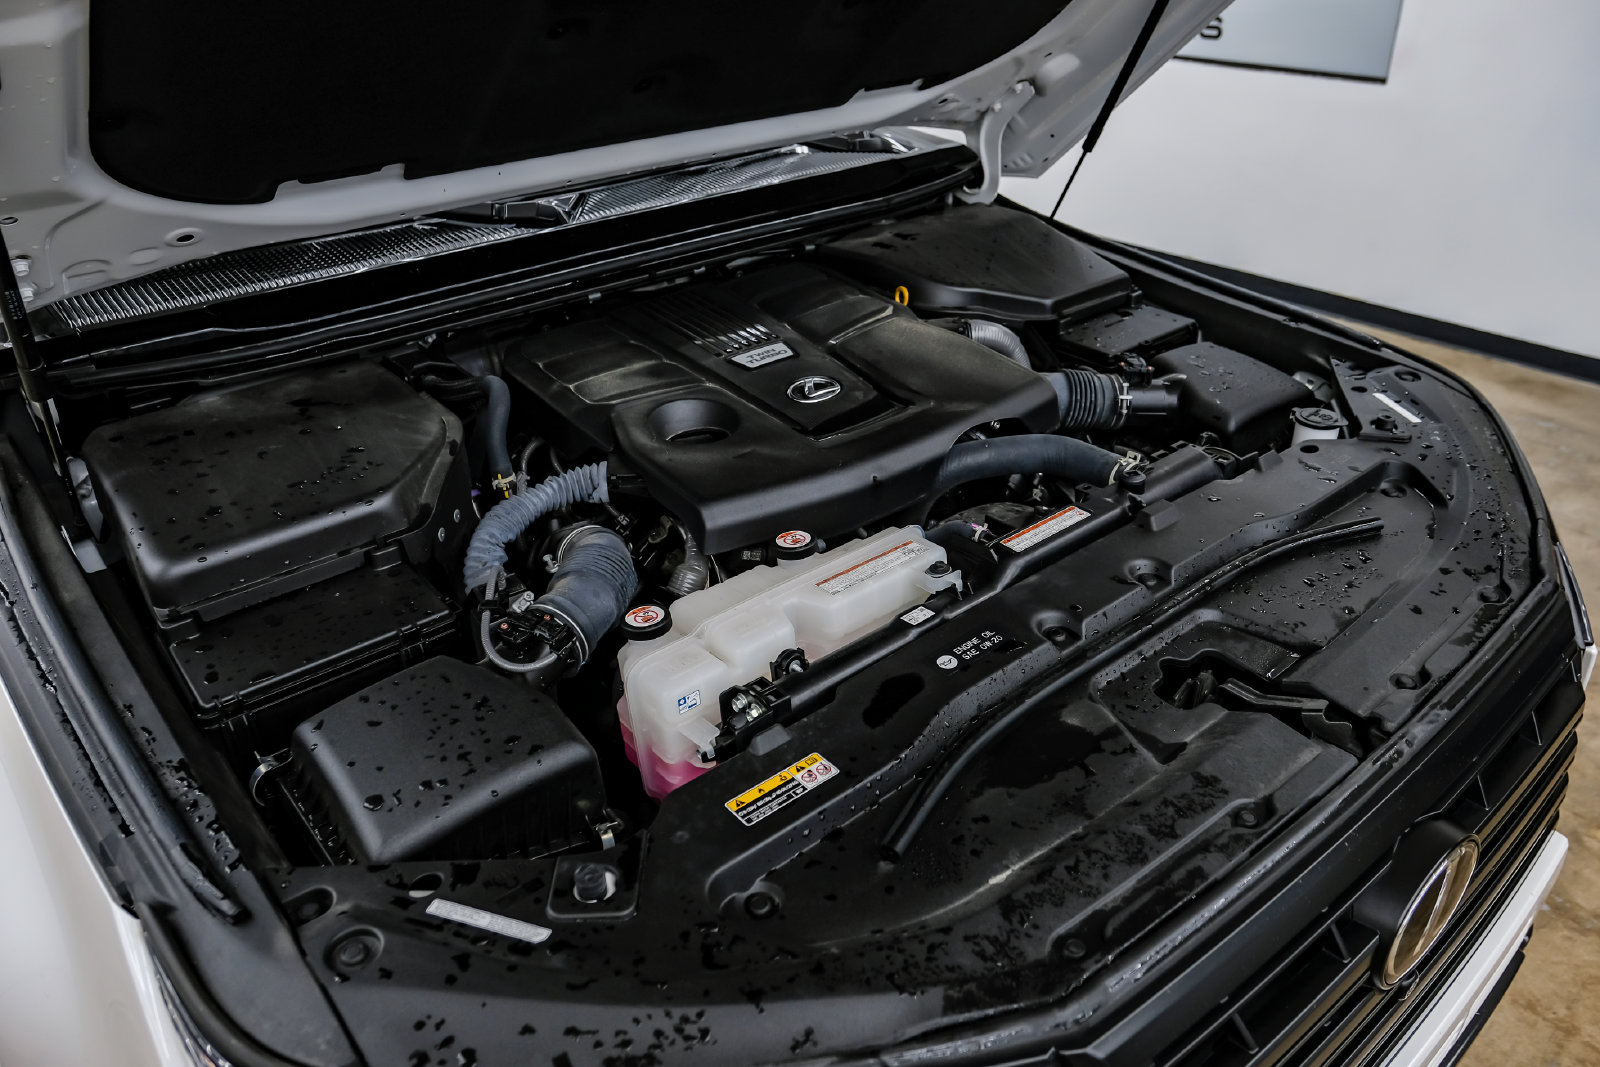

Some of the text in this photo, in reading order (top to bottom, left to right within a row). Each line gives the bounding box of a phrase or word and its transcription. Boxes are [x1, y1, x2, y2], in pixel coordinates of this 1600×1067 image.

[745, 349, 788, 364] TURBO
[746, 348, 777, 359] TWIN
[953, 630, 996, 655] ENGINE OIL
[962, 648, 980, 660] SAE
